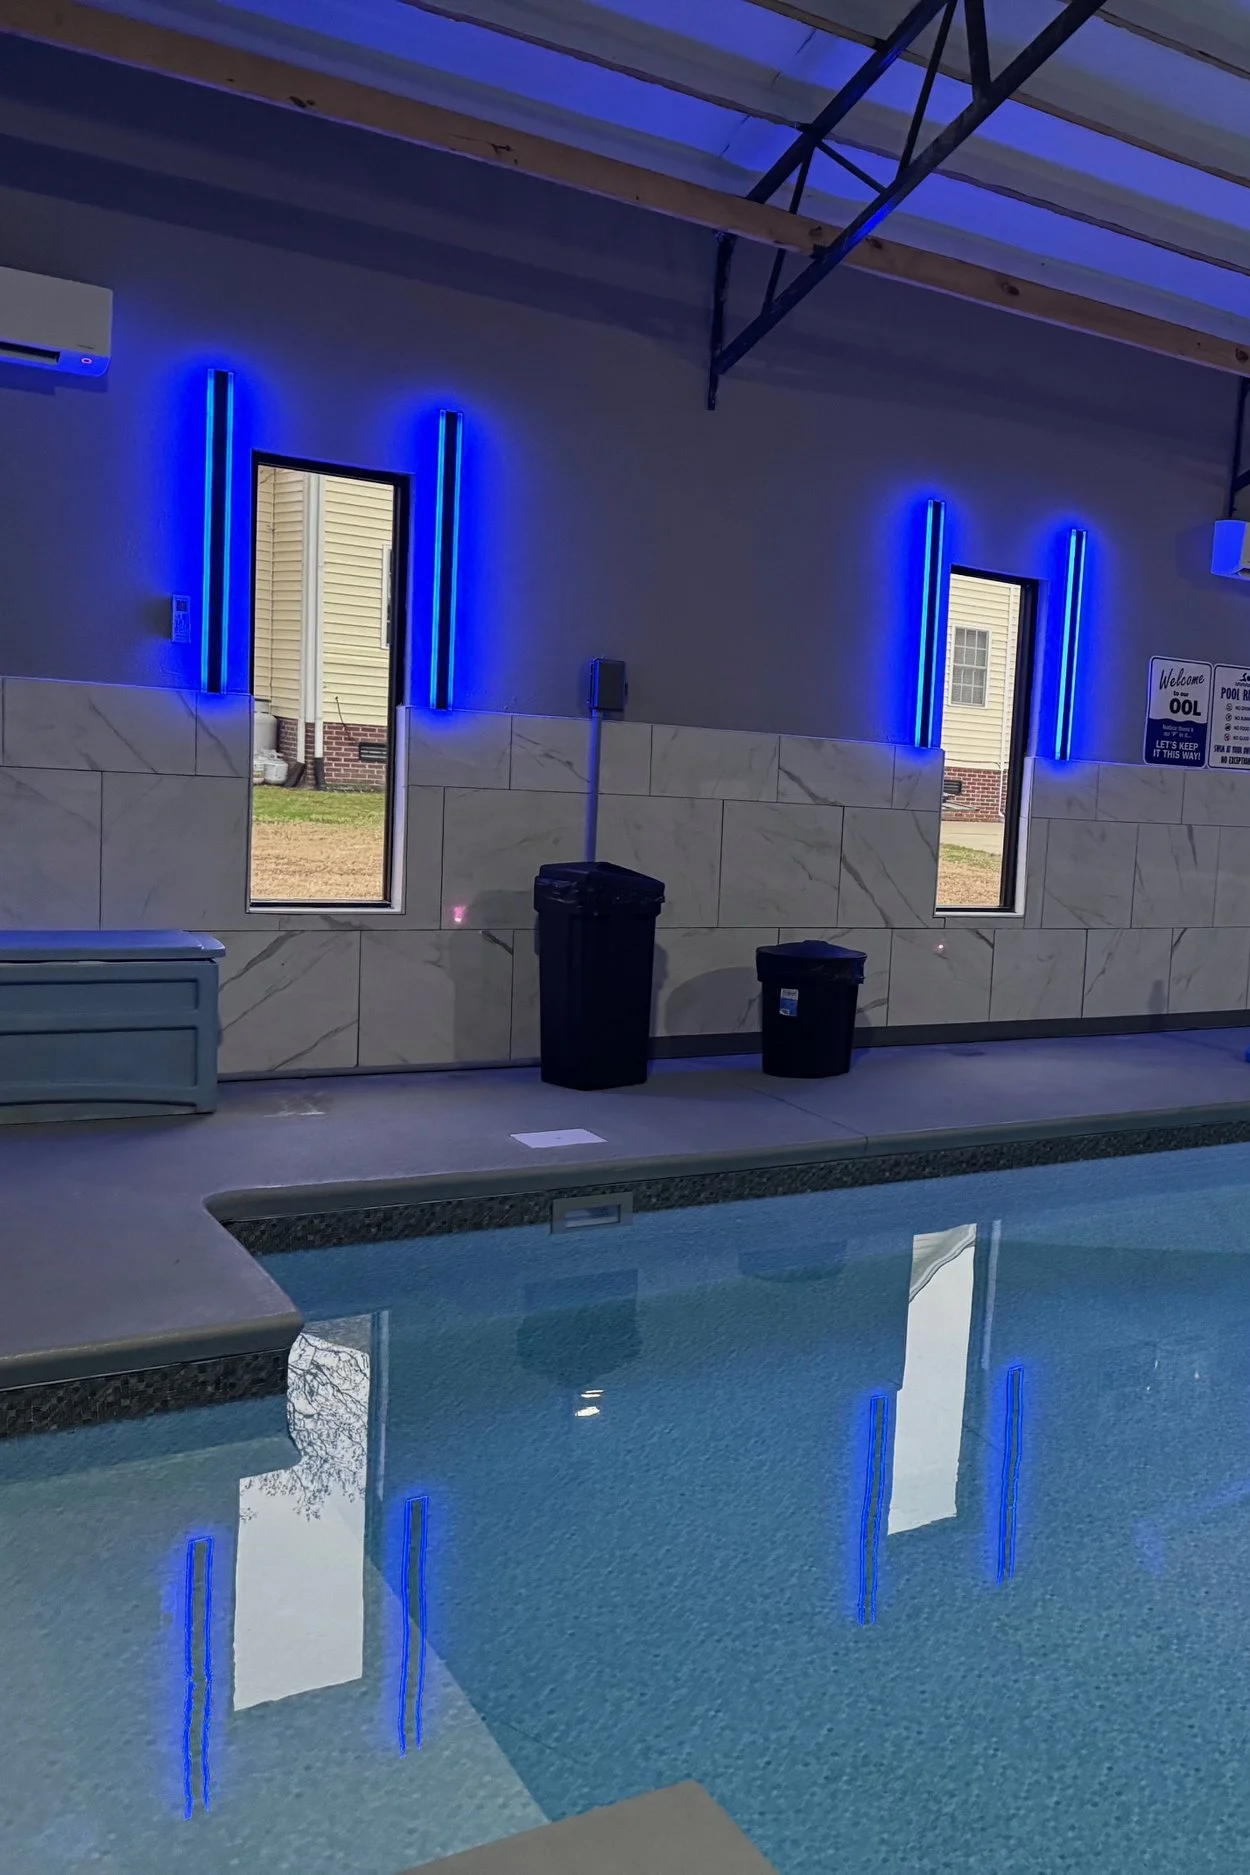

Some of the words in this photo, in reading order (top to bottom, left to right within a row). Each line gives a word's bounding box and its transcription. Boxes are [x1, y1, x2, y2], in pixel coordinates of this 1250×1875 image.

[1159, 668, 1205, 690] Welcome
[1221, 687, 1240, 701] POOL
[1170, 698, 1201, 716] OOL
[1156, 740, 1177, 749] LET'S
[1179, 741, 1199, 751] KEEP
[1153, 748, 1161, 758] IT
[1162, 749, 1180, 759] THIS
[1182, 750, 1201, 761] WAY!
[1220, 755, 1228, 764] NO
